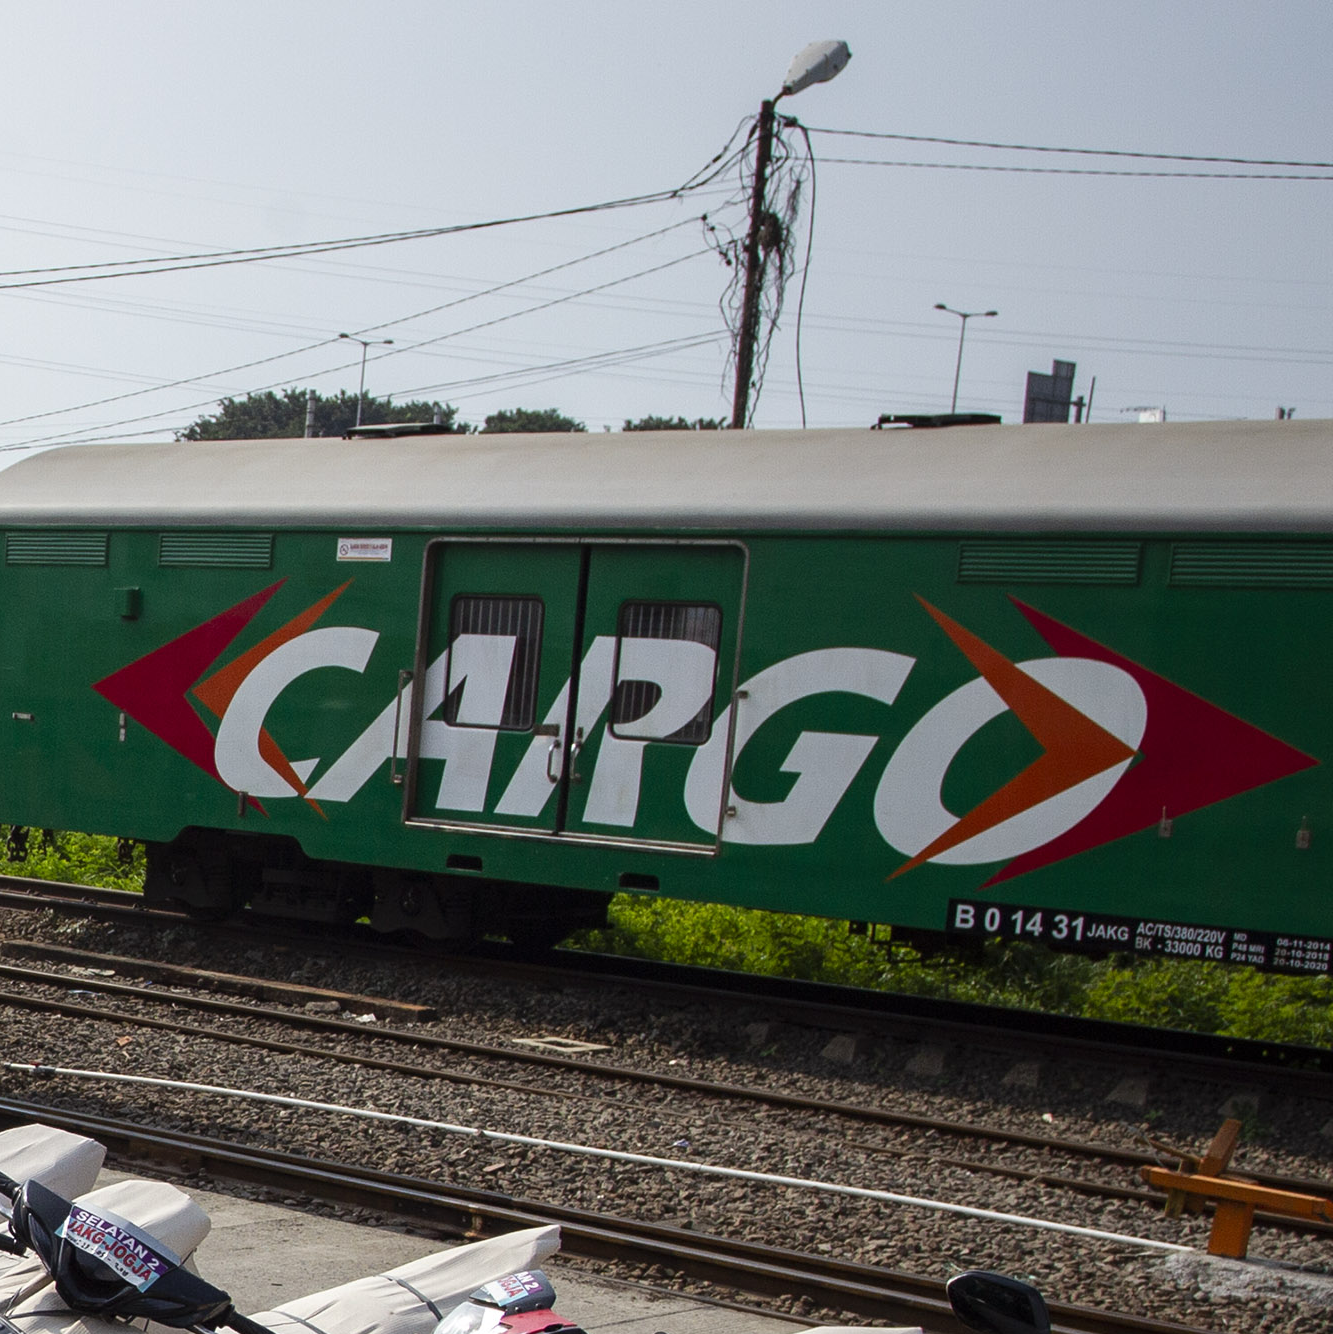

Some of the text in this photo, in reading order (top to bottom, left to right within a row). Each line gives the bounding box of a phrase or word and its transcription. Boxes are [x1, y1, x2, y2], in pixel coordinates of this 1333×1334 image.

[214, 625, 1148, 865] CARGO
[954, 903, 1130, 942] B 0 14 31 JAKG
[1136, 921, 1226, 944] AC/TS/380/220V
[1135, 936, 1224, 959] BK 33000 KG
[66, 1219, 153, 1282] JAKG-JOGJA
[76, 1210, 149, 1259] SELATAN
[147, 1256, 161, 1270] 2
